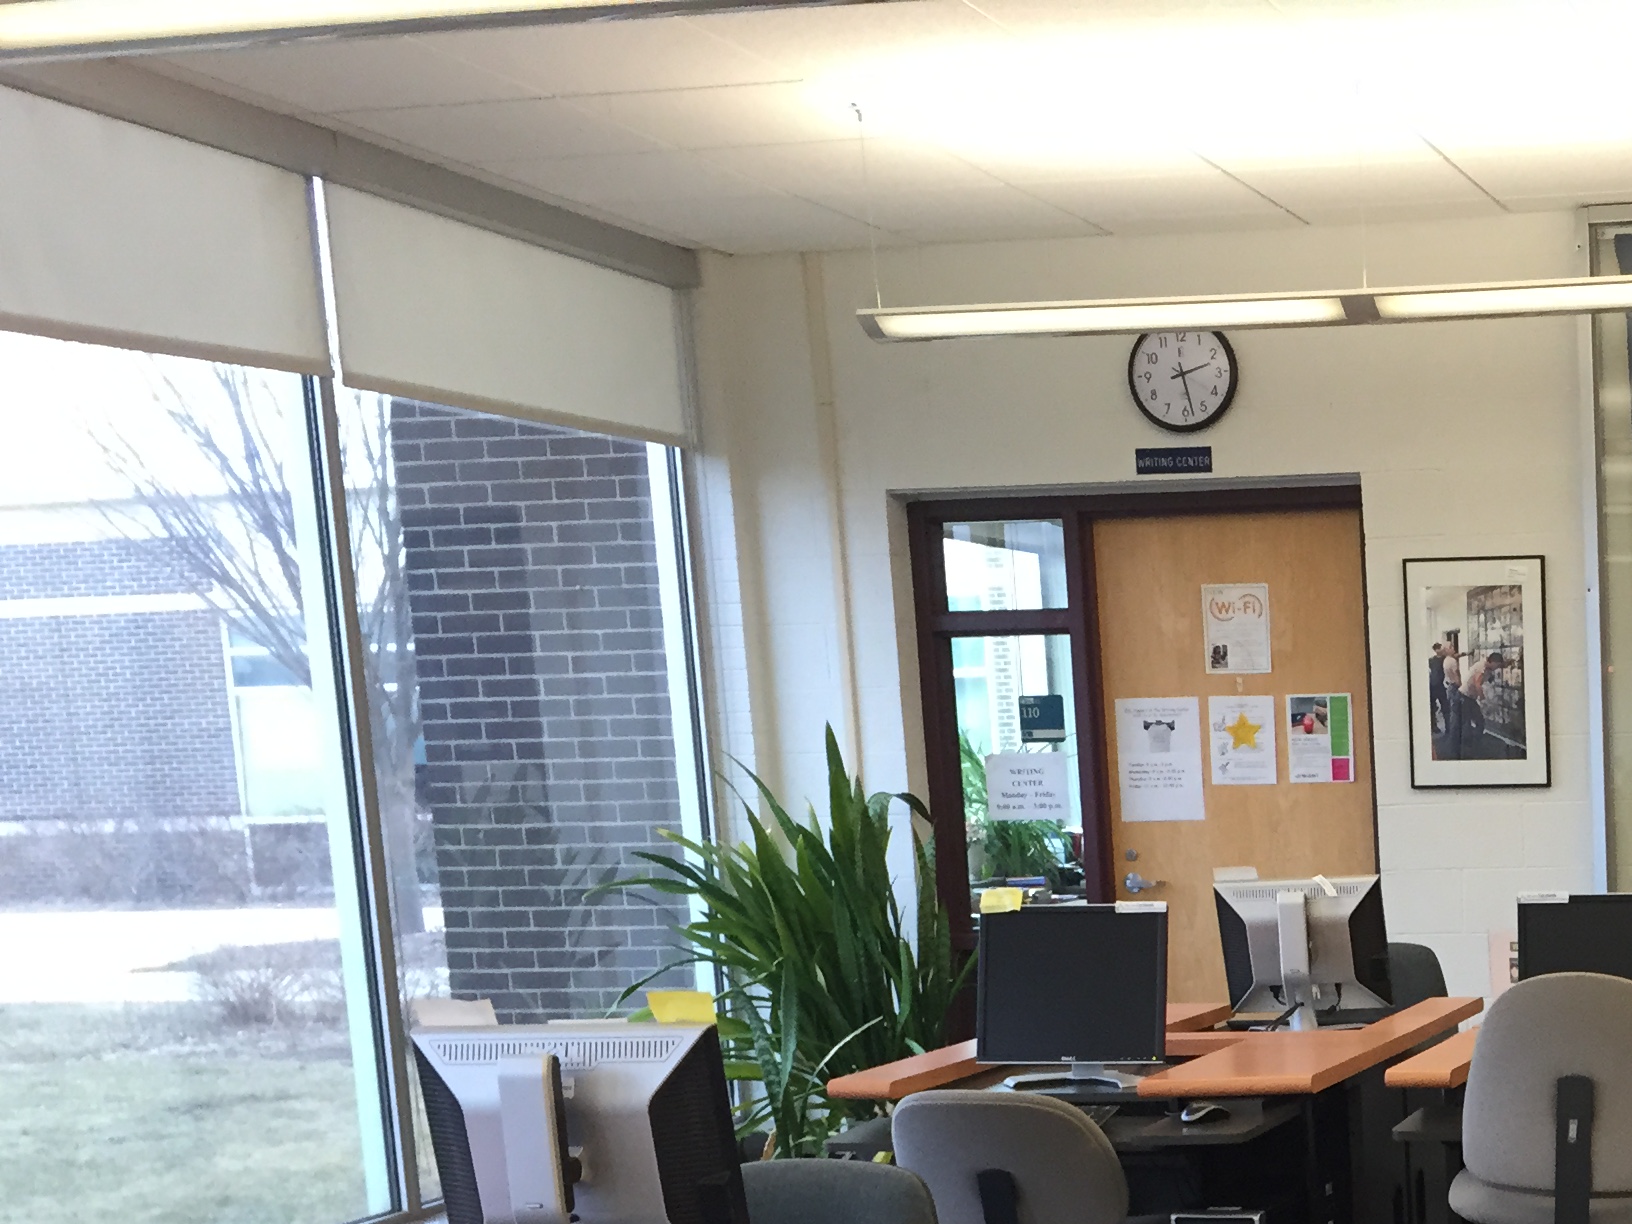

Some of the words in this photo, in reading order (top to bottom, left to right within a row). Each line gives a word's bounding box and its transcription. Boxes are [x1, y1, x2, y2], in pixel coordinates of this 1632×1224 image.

[1159, 337, 1168, 348] 11
[1176, 331, 1186, 342] 12
[1146, 352, 1158, 365] 10
[1210, 348, 1217, 360] 2
[1144, 371, 1152, 383] 9
[1215, 367, 1222, 379] 3
[1150, 389, 1158, 401] 8
[1210, 385, 1218, 397] 4
[1164, 403, 1171, 414] 7
[1182, 406, 1190, 417] 6
[1200, 400, 1207, 412] 5
[1138, 457, 1174, 468] WRITING
[1176, 456, 1210, 467] CENTER
[1215, 601, 1256, 614] Wi-Fi
[1021, 706, 1040, 718] 110
